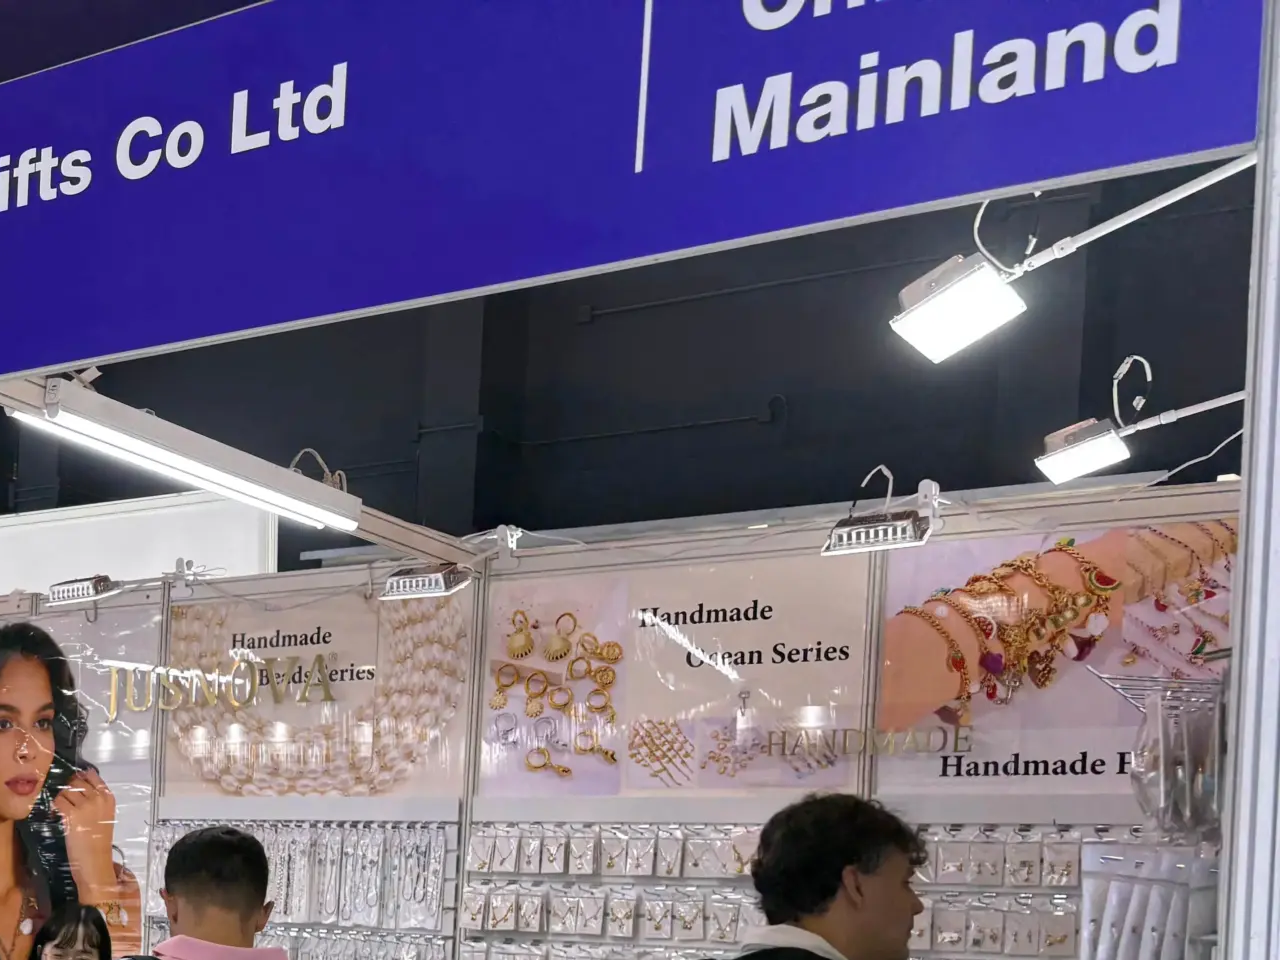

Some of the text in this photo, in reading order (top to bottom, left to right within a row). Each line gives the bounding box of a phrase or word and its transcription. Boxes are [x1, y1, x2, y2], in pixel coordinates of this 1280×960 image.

[712, 0, 1180, 163] Mainland
[116, 116, 204, 181] Co
[230, 61, 348, 155] Ltd
[638, 599, 773, 628] Handmade
[231, 626, 332, 650] Handmade
[771, 641, 850, 665] Series
[105, 653, 336, 723] JUSNOVA
[767, 725, 973, 756] HANDMADE
[939, 752, 1106, 777] Handmade
